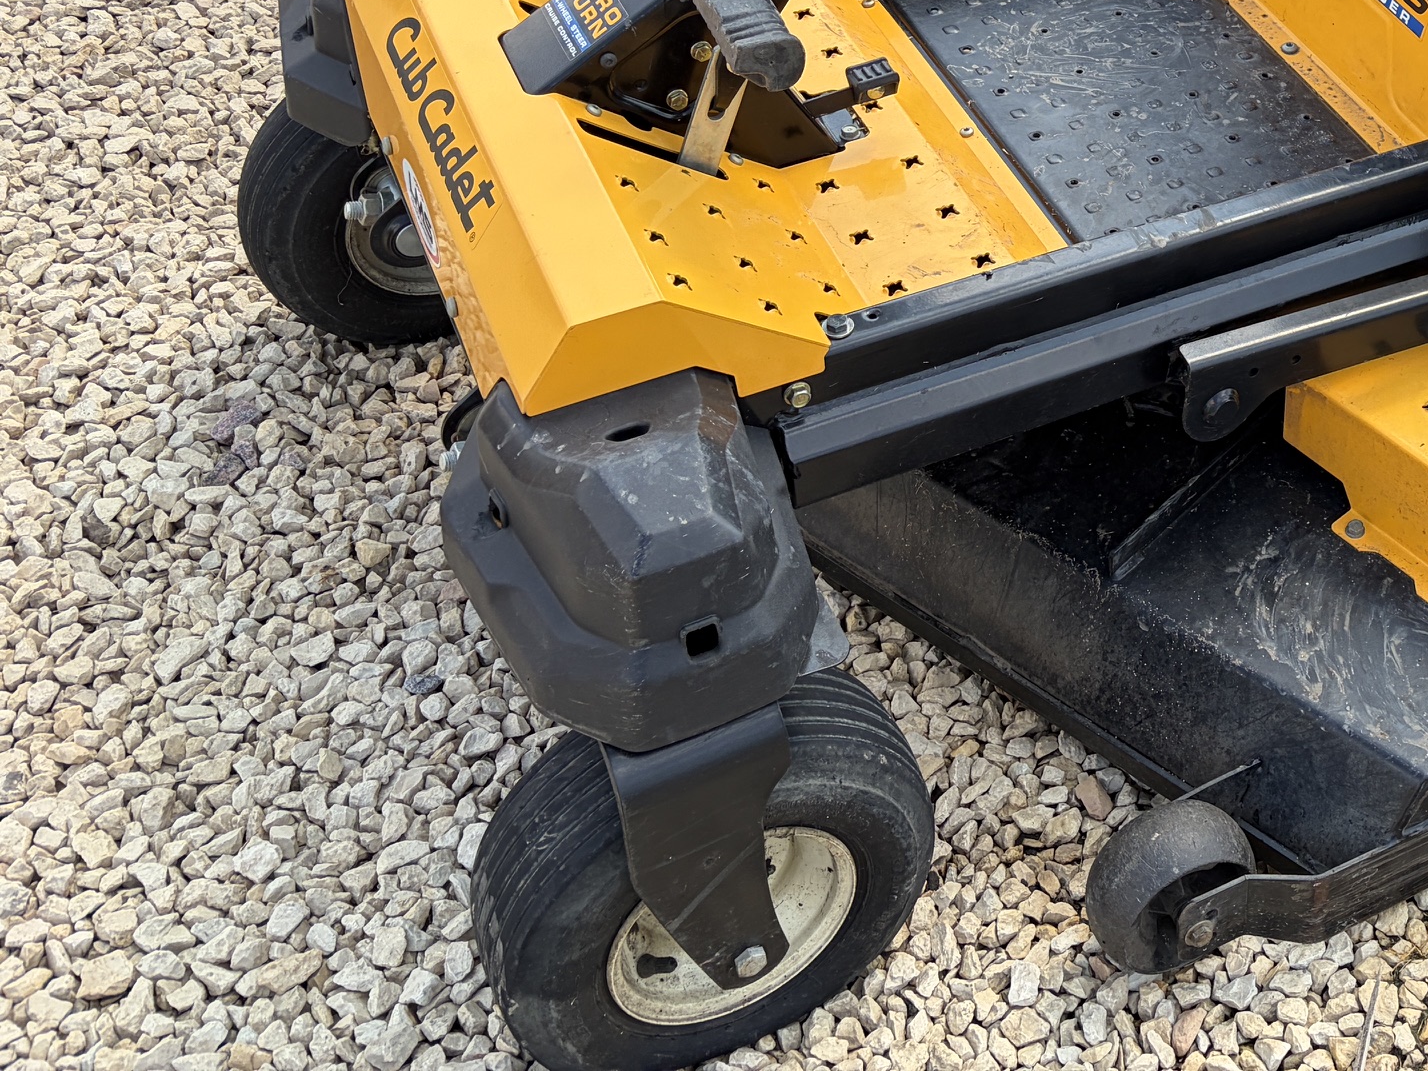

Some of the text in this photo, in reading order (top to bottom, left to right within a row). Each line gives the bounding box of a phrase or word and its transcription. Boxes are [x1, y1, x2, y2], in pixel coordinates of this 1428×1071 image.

[544, 2, 579, 57] CRUISE CONTROL
[570, 24, 588, 48] STEER
[386, 17, 496, 234] Cub Cadet
